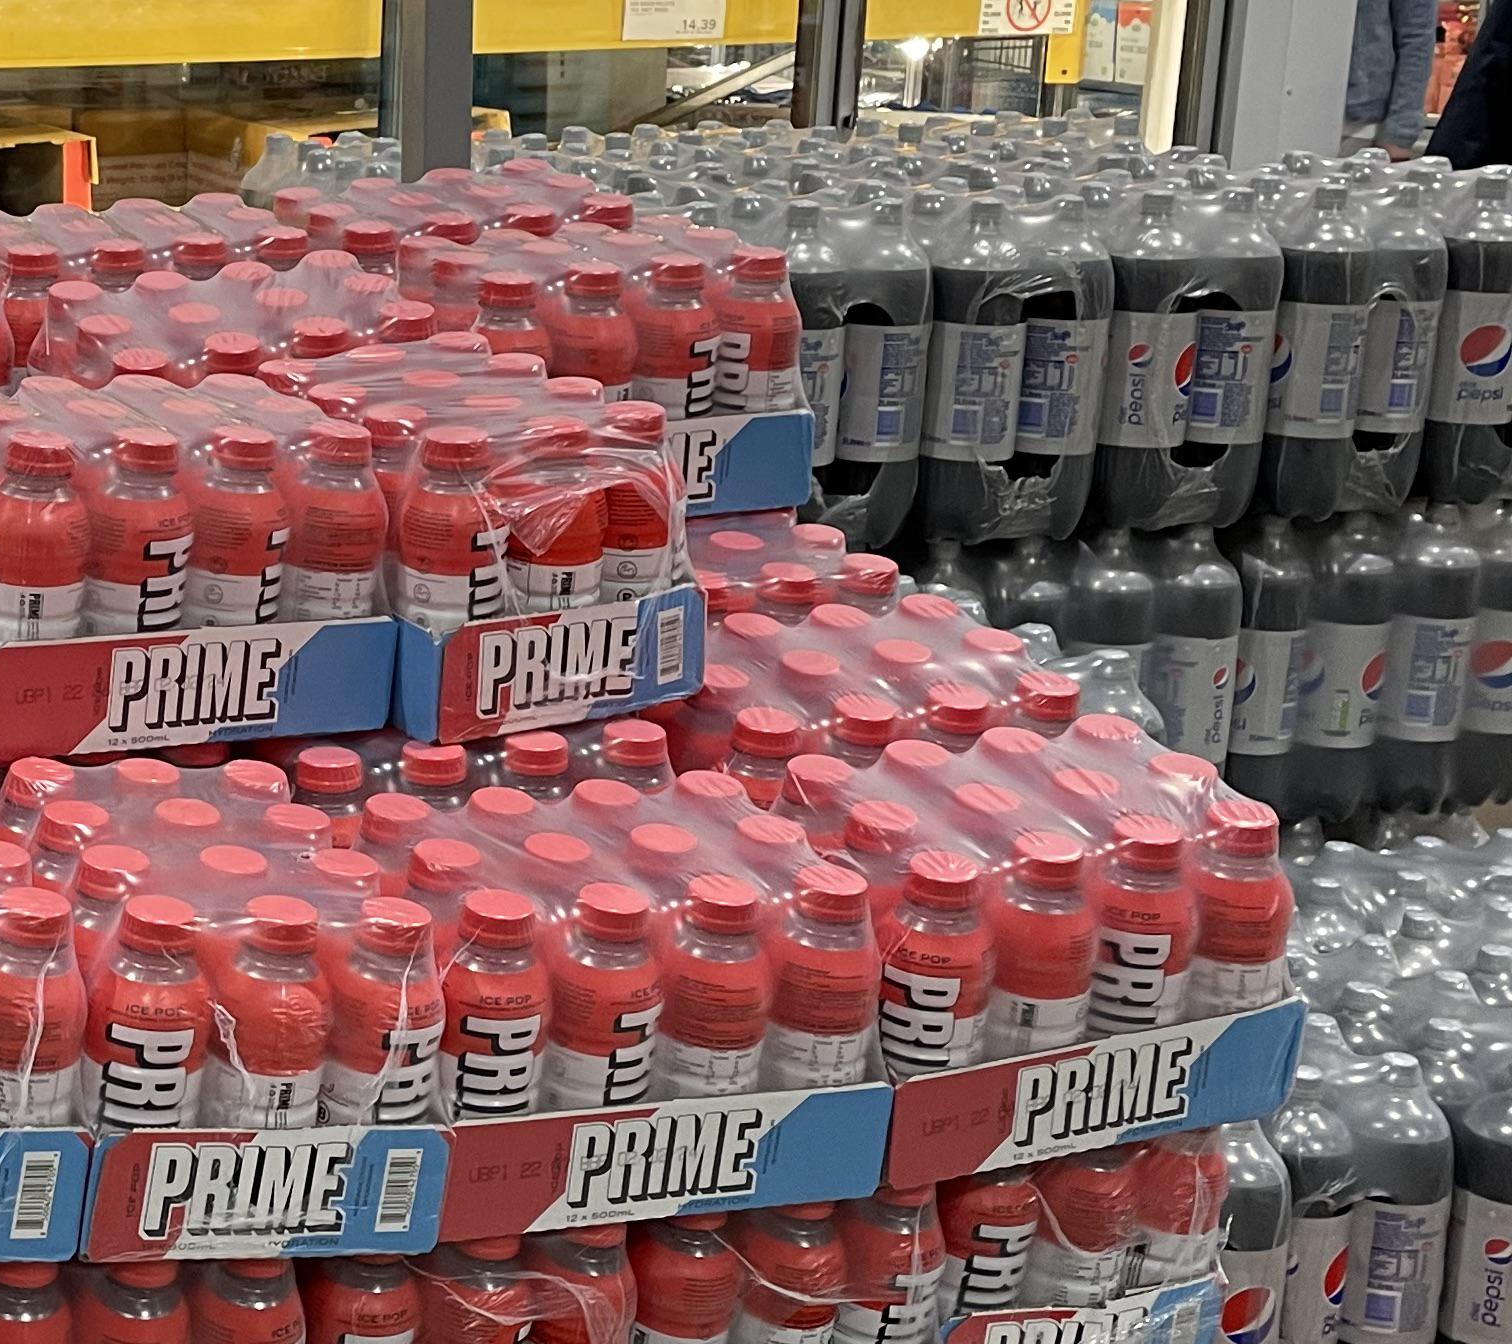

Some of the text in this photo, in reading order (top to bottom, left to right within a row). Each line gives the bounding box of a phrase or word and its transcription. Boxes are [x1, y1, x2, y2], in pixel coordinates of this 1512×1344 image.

[681, 18, 717, 31] 14.39
[1129, 373, 1145, 426] pepsi
[1455, 385, 1503, 403] pepsi
[109, 638, 282, 733] PRIME
[476, 615, 638, 719] PRIME
[1211, 695, 1224, 744] pepsi
[1013, 1034, 1193, 1148] PRIME
[139, 1140, 353, 1238] PRIME
[566, 1108, 764, 1209] PRIME
[1480, 1268, 1503, 1327] pepsi
